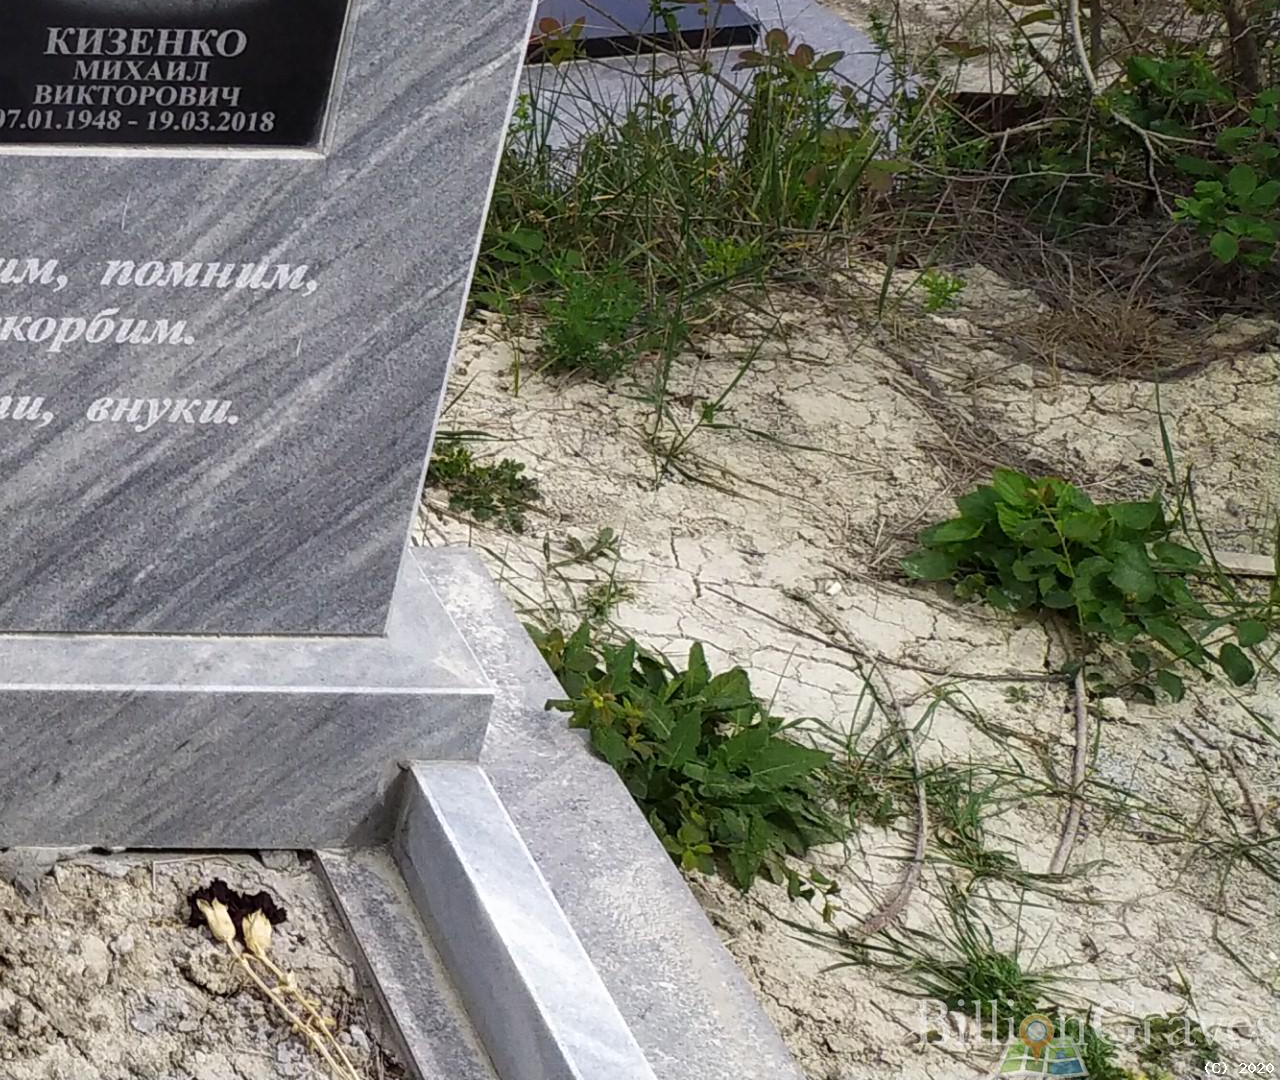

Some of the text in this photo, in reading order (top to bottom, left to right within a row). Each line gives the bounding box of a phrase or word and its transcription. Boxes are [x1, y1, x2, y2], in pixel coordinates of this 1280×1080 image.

[43, 27, 247, 57] КИЗЕНКО
[73, 60, 210, 82] МИХАИЛ
[33, 84, 242, 107] ВИКТОРОВИЧ
[146, 110, 276, 132] 19.03.2018
[100, 256, 318, 297] помним,
[86, 396, 239, 432] внуки.
